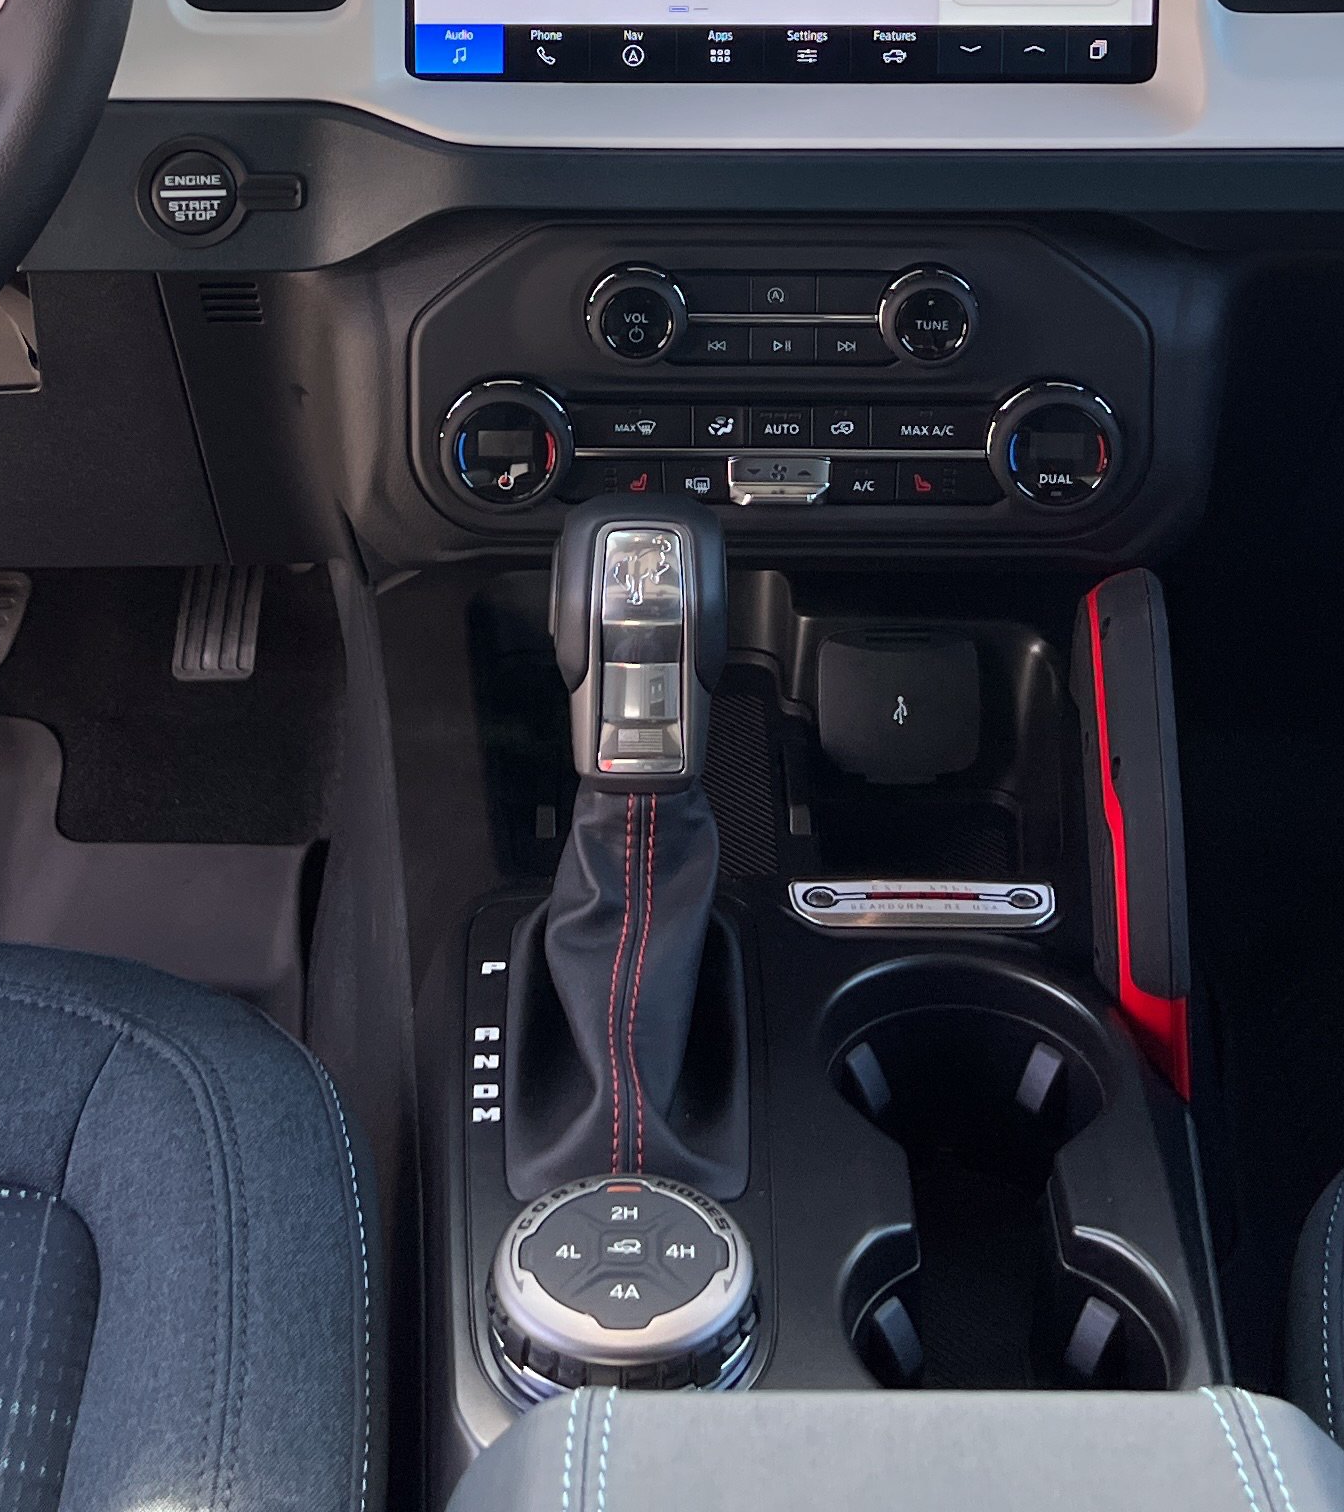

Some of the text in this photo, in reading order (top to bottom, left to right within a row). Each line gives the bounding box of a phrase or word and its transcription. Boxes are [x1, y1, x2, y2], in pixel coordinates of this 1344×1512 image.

[444, 29, 475, 42] Audio
[530, 29, 563, 42] Phone
[623, 29, 644, 42] Nav
[707, 29, 734, 44] Apps
[786, 29, 829, 44] Settings
[872, 29, 917, 42] Features
[164, 174, 222, 186] ENGINE
[168, 200, 221, 212] START
[174, 210, 217, 222] STOP
[622, 311, 649, 324] VOL
[914, 319, 950, 331] TUNE
[613, 423, 637, 434] MAX
[763, 423, 801, 436] AUTO
[900, 424, 955, 437] MAX A/C
[684, 477, 694, 489] R
[852, 478, 875, 493] A/C
[1038, 472, 1073, 486] DUAL
[480, 960, 507, 976] P
[474, 1026, 501, 1041] R
[472, 1054, 501, 1069] N
[472, 1083, 500, 1099] D
[471, 1106, 502, 1123] M
[611, 1205, 639, 1221] 2H
[656, 1180, 732, 1232] MODES
[555, 1244, 582, 1260] 4L
[665, 1243, 696, 1259] 4H
[608, 1283, 641, 1300] 4A
